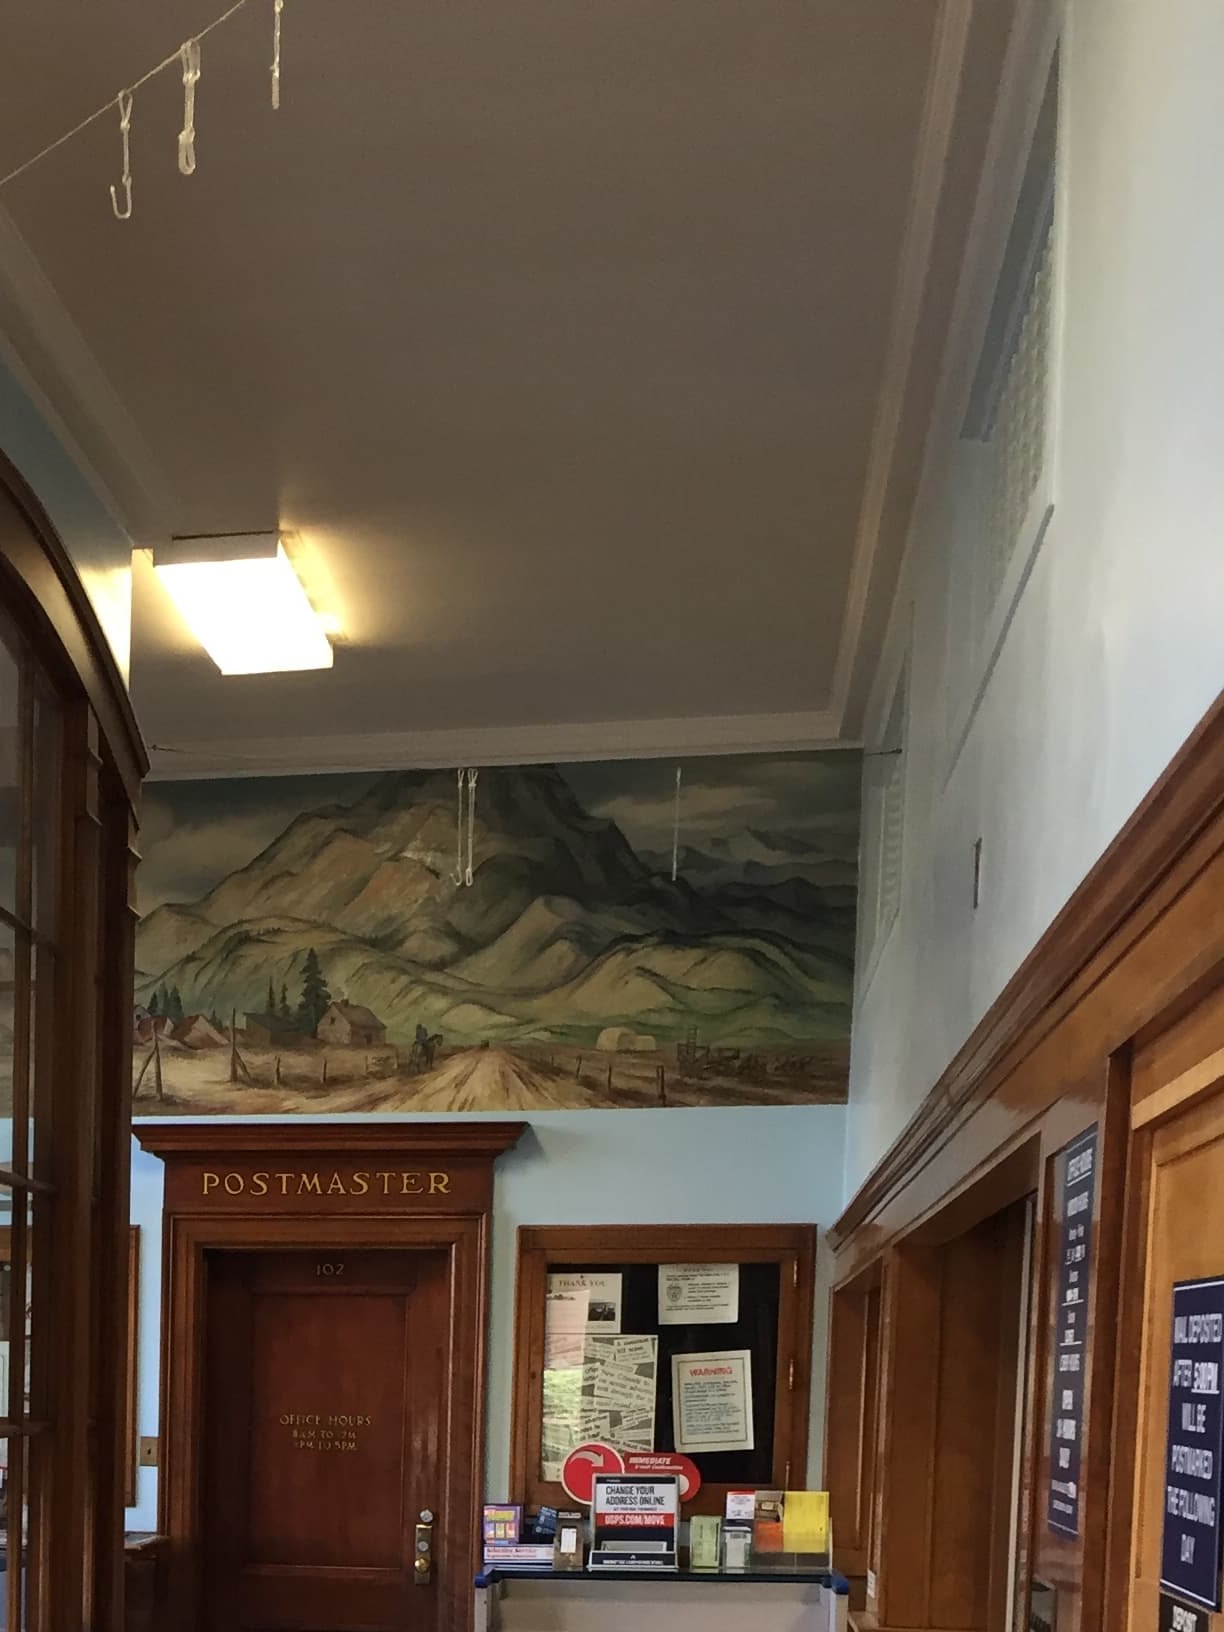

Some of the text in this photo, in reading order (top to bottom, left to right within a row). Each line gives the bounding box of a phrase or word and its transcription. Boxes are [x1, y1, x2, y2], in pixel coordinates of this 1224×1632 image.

[201, 1172, 452, 1195] POSTMASTER
[316, 1263, 345, 1276] 102
[605, 1486, 655, 1495] CHANGE YOUR
[605, 1496, 665, 1505] ADDRESS ONLINE
